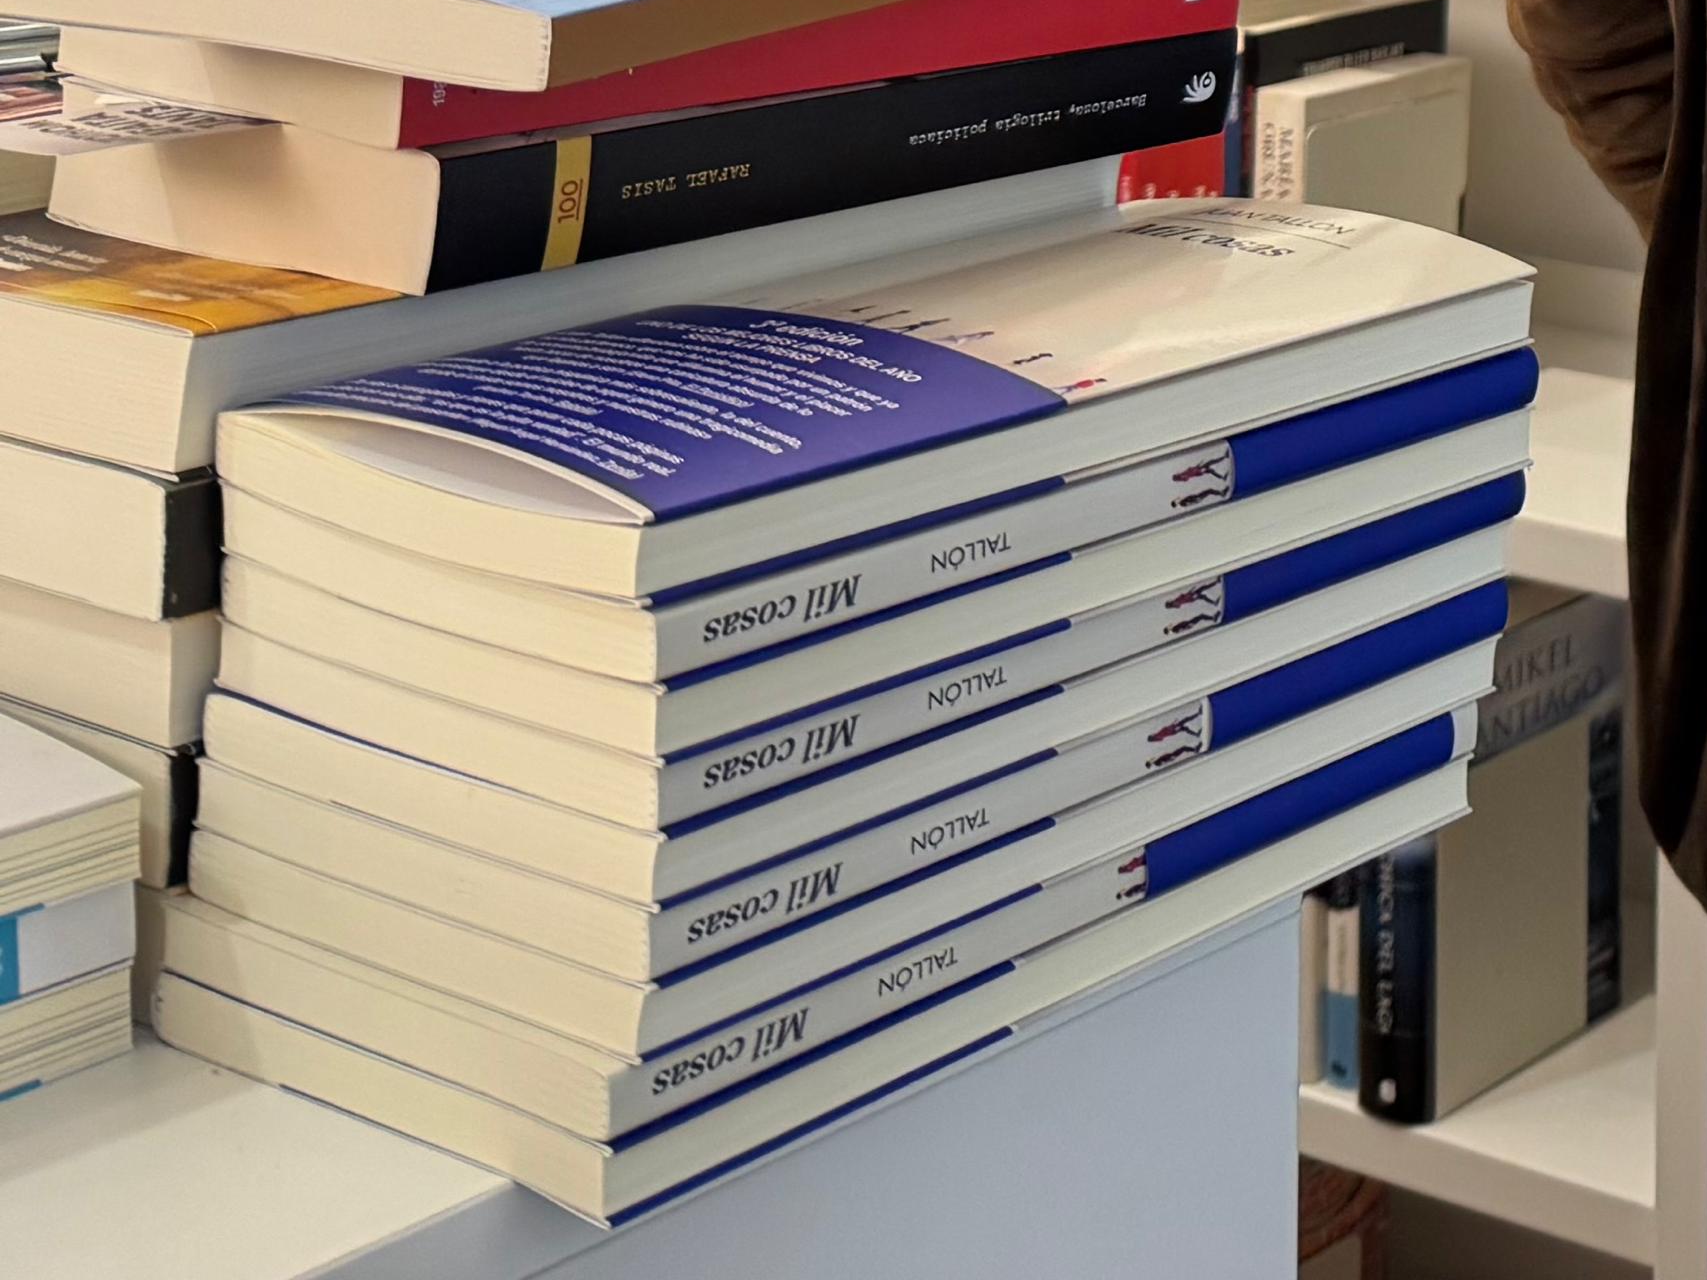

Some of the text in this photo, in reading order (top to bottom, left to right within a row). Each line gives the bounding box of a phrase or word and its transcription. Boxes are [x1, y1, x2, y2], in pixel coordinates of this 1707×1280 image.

[908, 91, 1147, 146] Barcelona, trilogia policíaca
[557, 179, 584, 224] 100
[620, 163, 751, 200] RAFAEL TASIS
[930, 531, 1011, 573] TALLÓN
[702, 574, 862, 643] Mil cosas
